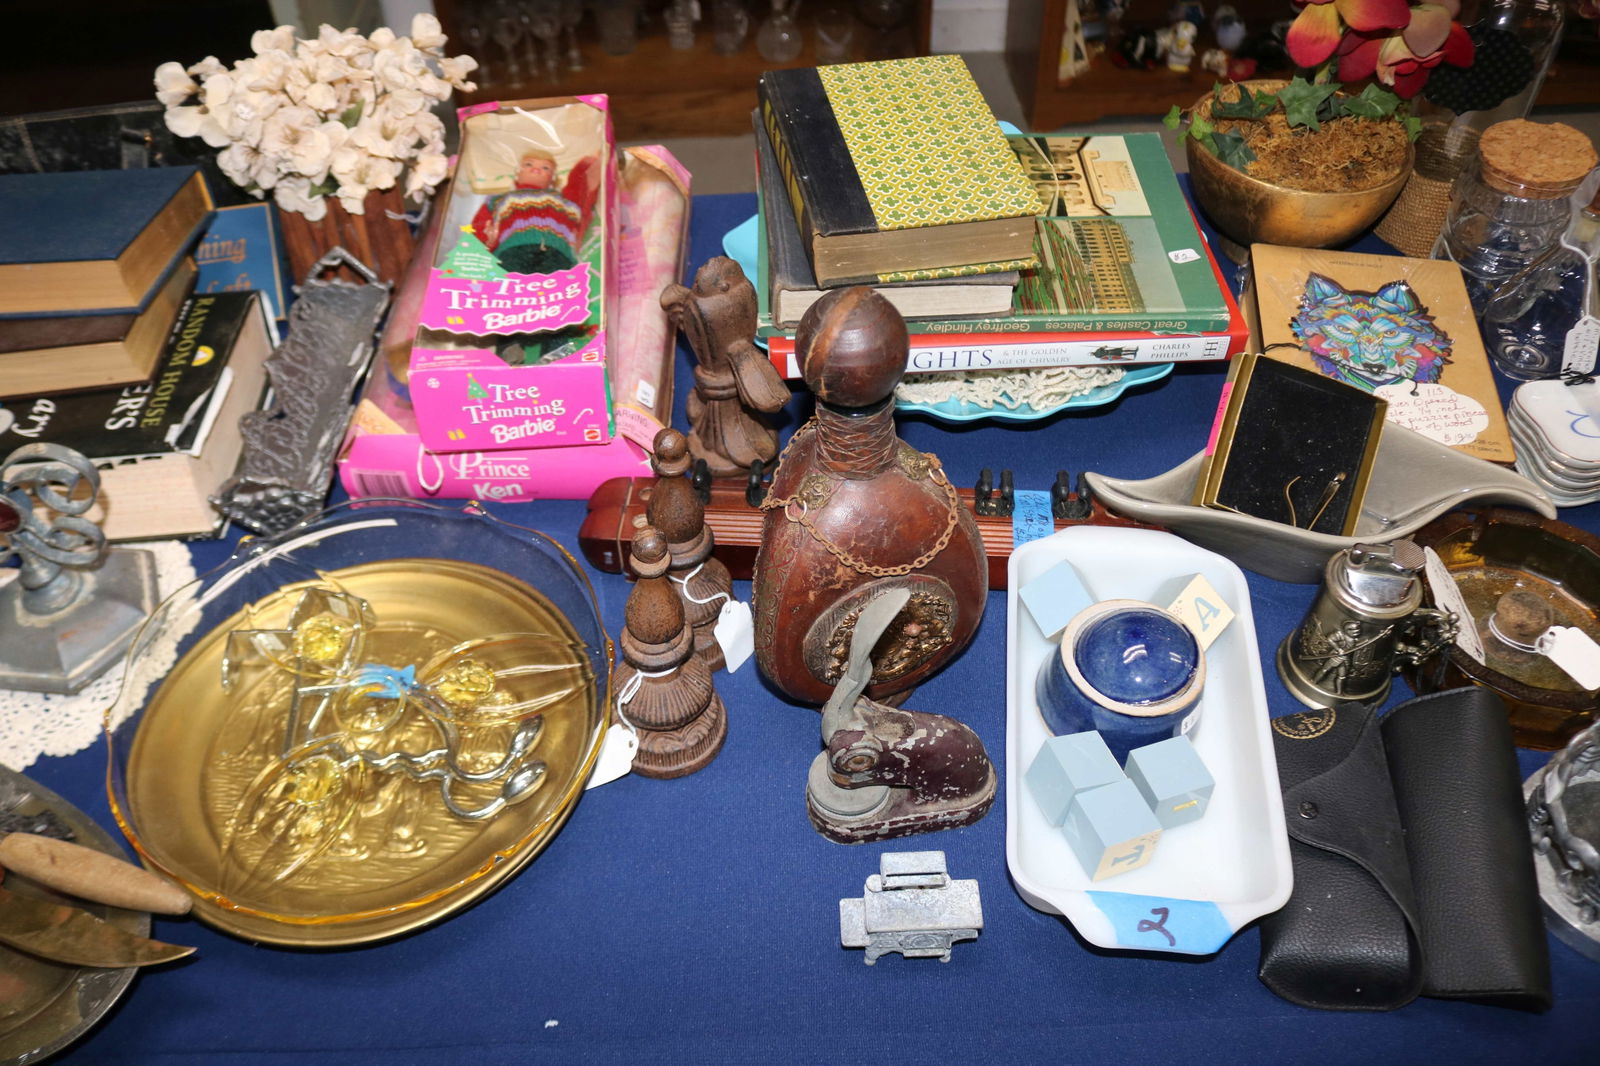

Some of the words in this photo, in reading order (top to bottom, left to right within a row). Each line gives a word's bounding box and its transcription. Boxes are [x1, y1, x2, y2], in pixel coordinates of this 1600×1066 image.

[493, 277, 558, 296] Tree
[440, 282, 582, 310] Trimming
[482, 304, 562, 331] Barbie
[1045, 321, 1092, 332] Palaces
[1095, 321, 1104, 331] &
[1106, 320, 1151, 331] Castles
[1153, 320, 1188, 331] Great
[168, 296, 216, 369] RANDOM
[926, 322, 973, 334] Hindley
[975, 322, 1031, 332] Geoffrey
[1012, 349, 1029, 357] THE
[1031, 347, 1067, 356] GOLDEN
[1150, 351, 1189, 360] PHILLIPS
[1152, 342, 1191, 351] CHARLES
[997, 358, 1010, 366] AGE
[1029, 356, 1072, 365] CHIVALRY
[140, 370, 183, 428] HOUSE
[487, 383, 541, 404] Tree
[462, 398, 566, 425] Trimming
[490, 418, 556, 444] Barbie
[449, 451, 532, 480] Prince
[473, 482, 524, 500] Ken
[1194, 597, 1221, 632] A
